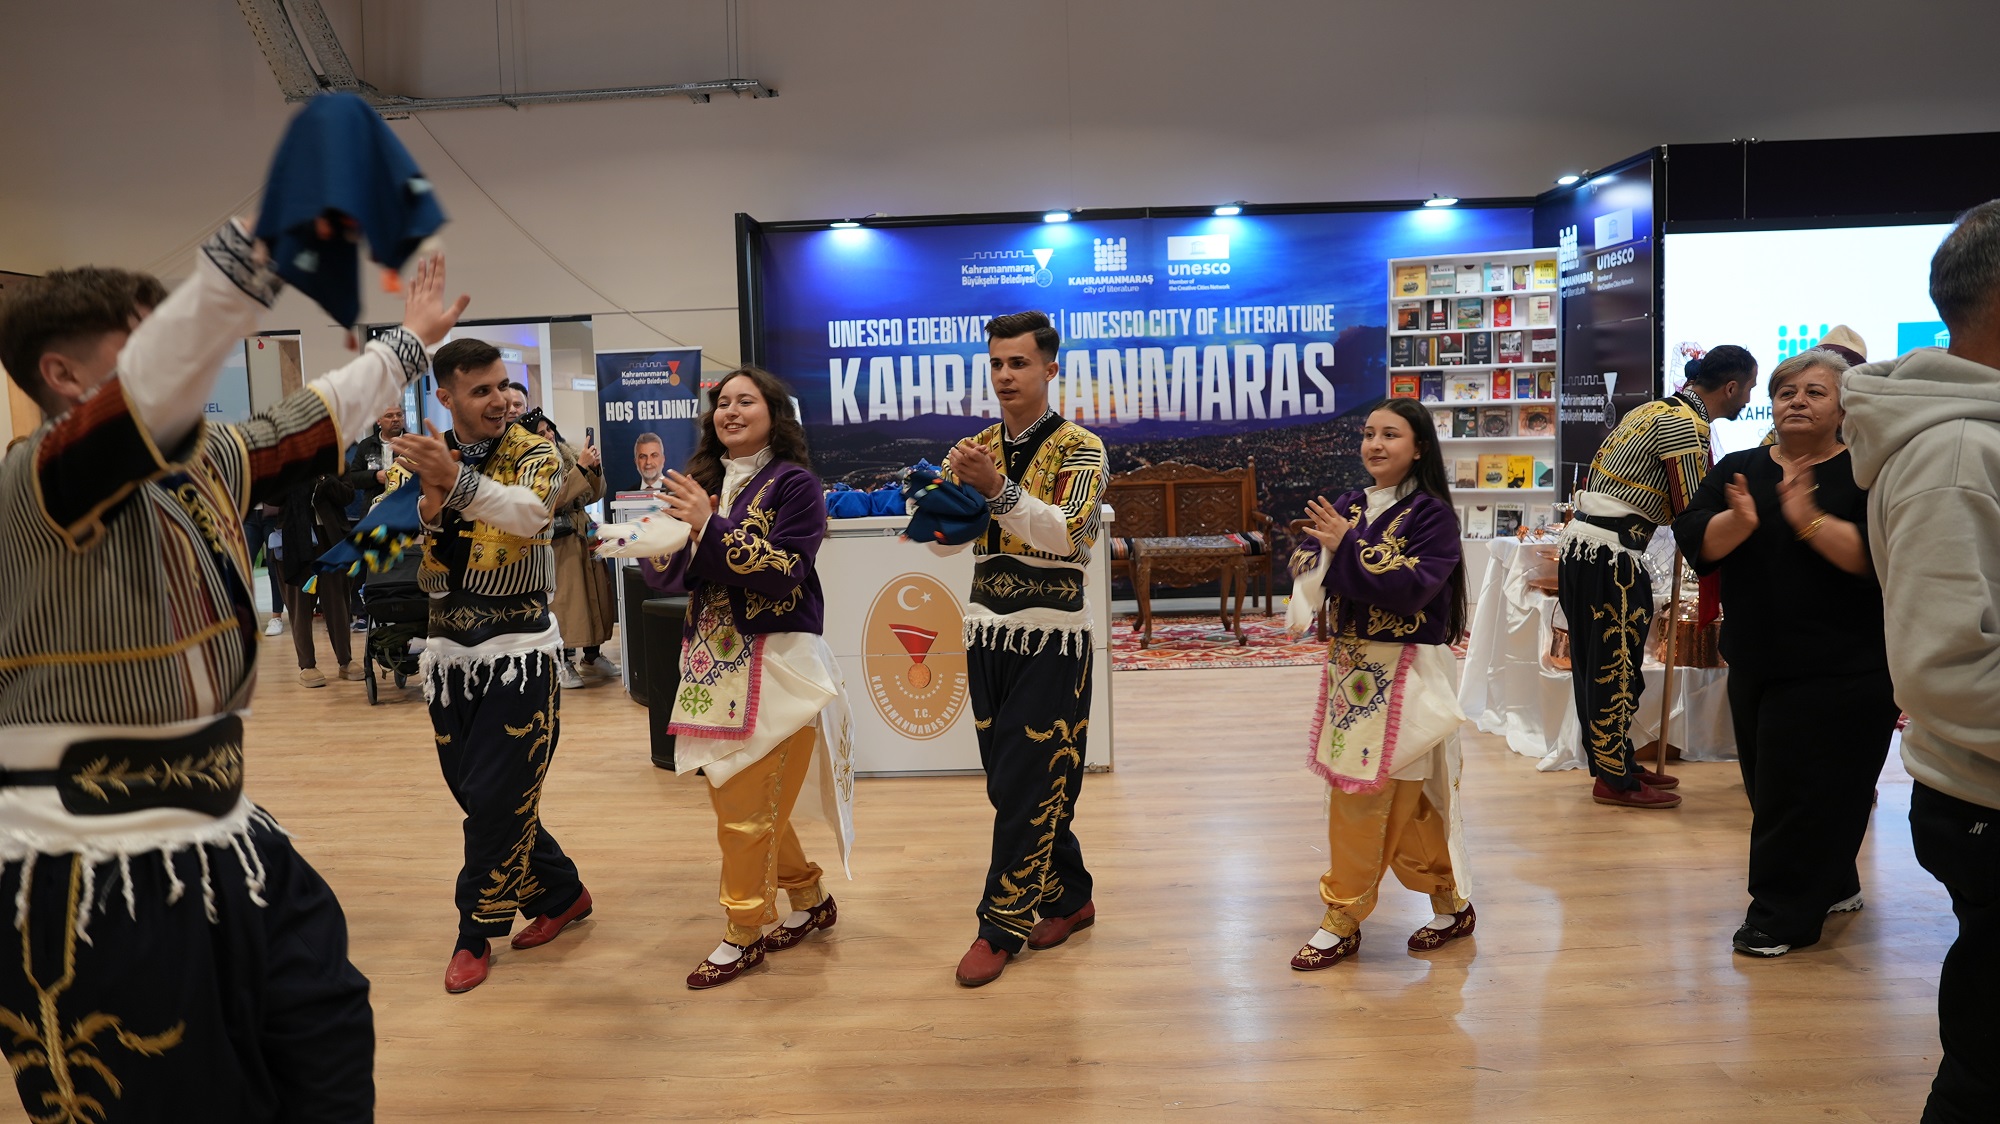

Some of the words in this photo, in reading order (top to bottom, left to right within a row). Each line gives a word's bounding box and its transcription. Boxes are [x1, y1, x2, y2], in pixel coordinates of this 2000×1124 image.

[1596, 247, 1635, 270] unesco
[961, 264, 1035, 274] Kahramanmaraş
[1168, 262, 1231, 276] unesco
[962, 275, 1000, 287] Büyükşehir
[1000, 273, 1036, 285] Belediyesi
[1068, 274, 1154, 286] KAHRAMANMARAŞ
[1083, 285, 1097, 295] city
[1097, 285, 1106, 293] of
[1107, 284, 1139, 293] literature
[828, 319, 903, 349] UNESCO
[1070, 310, 1145, 340] UNESCO
[1149, 308, 1191, 336] CITY
[1196, 307, 1218, 335] OF
[1224, 304, 1335, 334] LITERATURE
[621, 370, 669, 379] Kahramanmaraş
[622, 378, 647, 386] Büyükşehir
[647, 377, 670, 385] Belediyesi
[202, 402, 223, 413] ZEL
[605, 401, 634, 423] HOŞ
[637, 399, 699, 420] GELDİNİZ
[871, 675, 945, 734] KAHRAMANMARAŞ
[914, 708, 932, 718] T.C.
